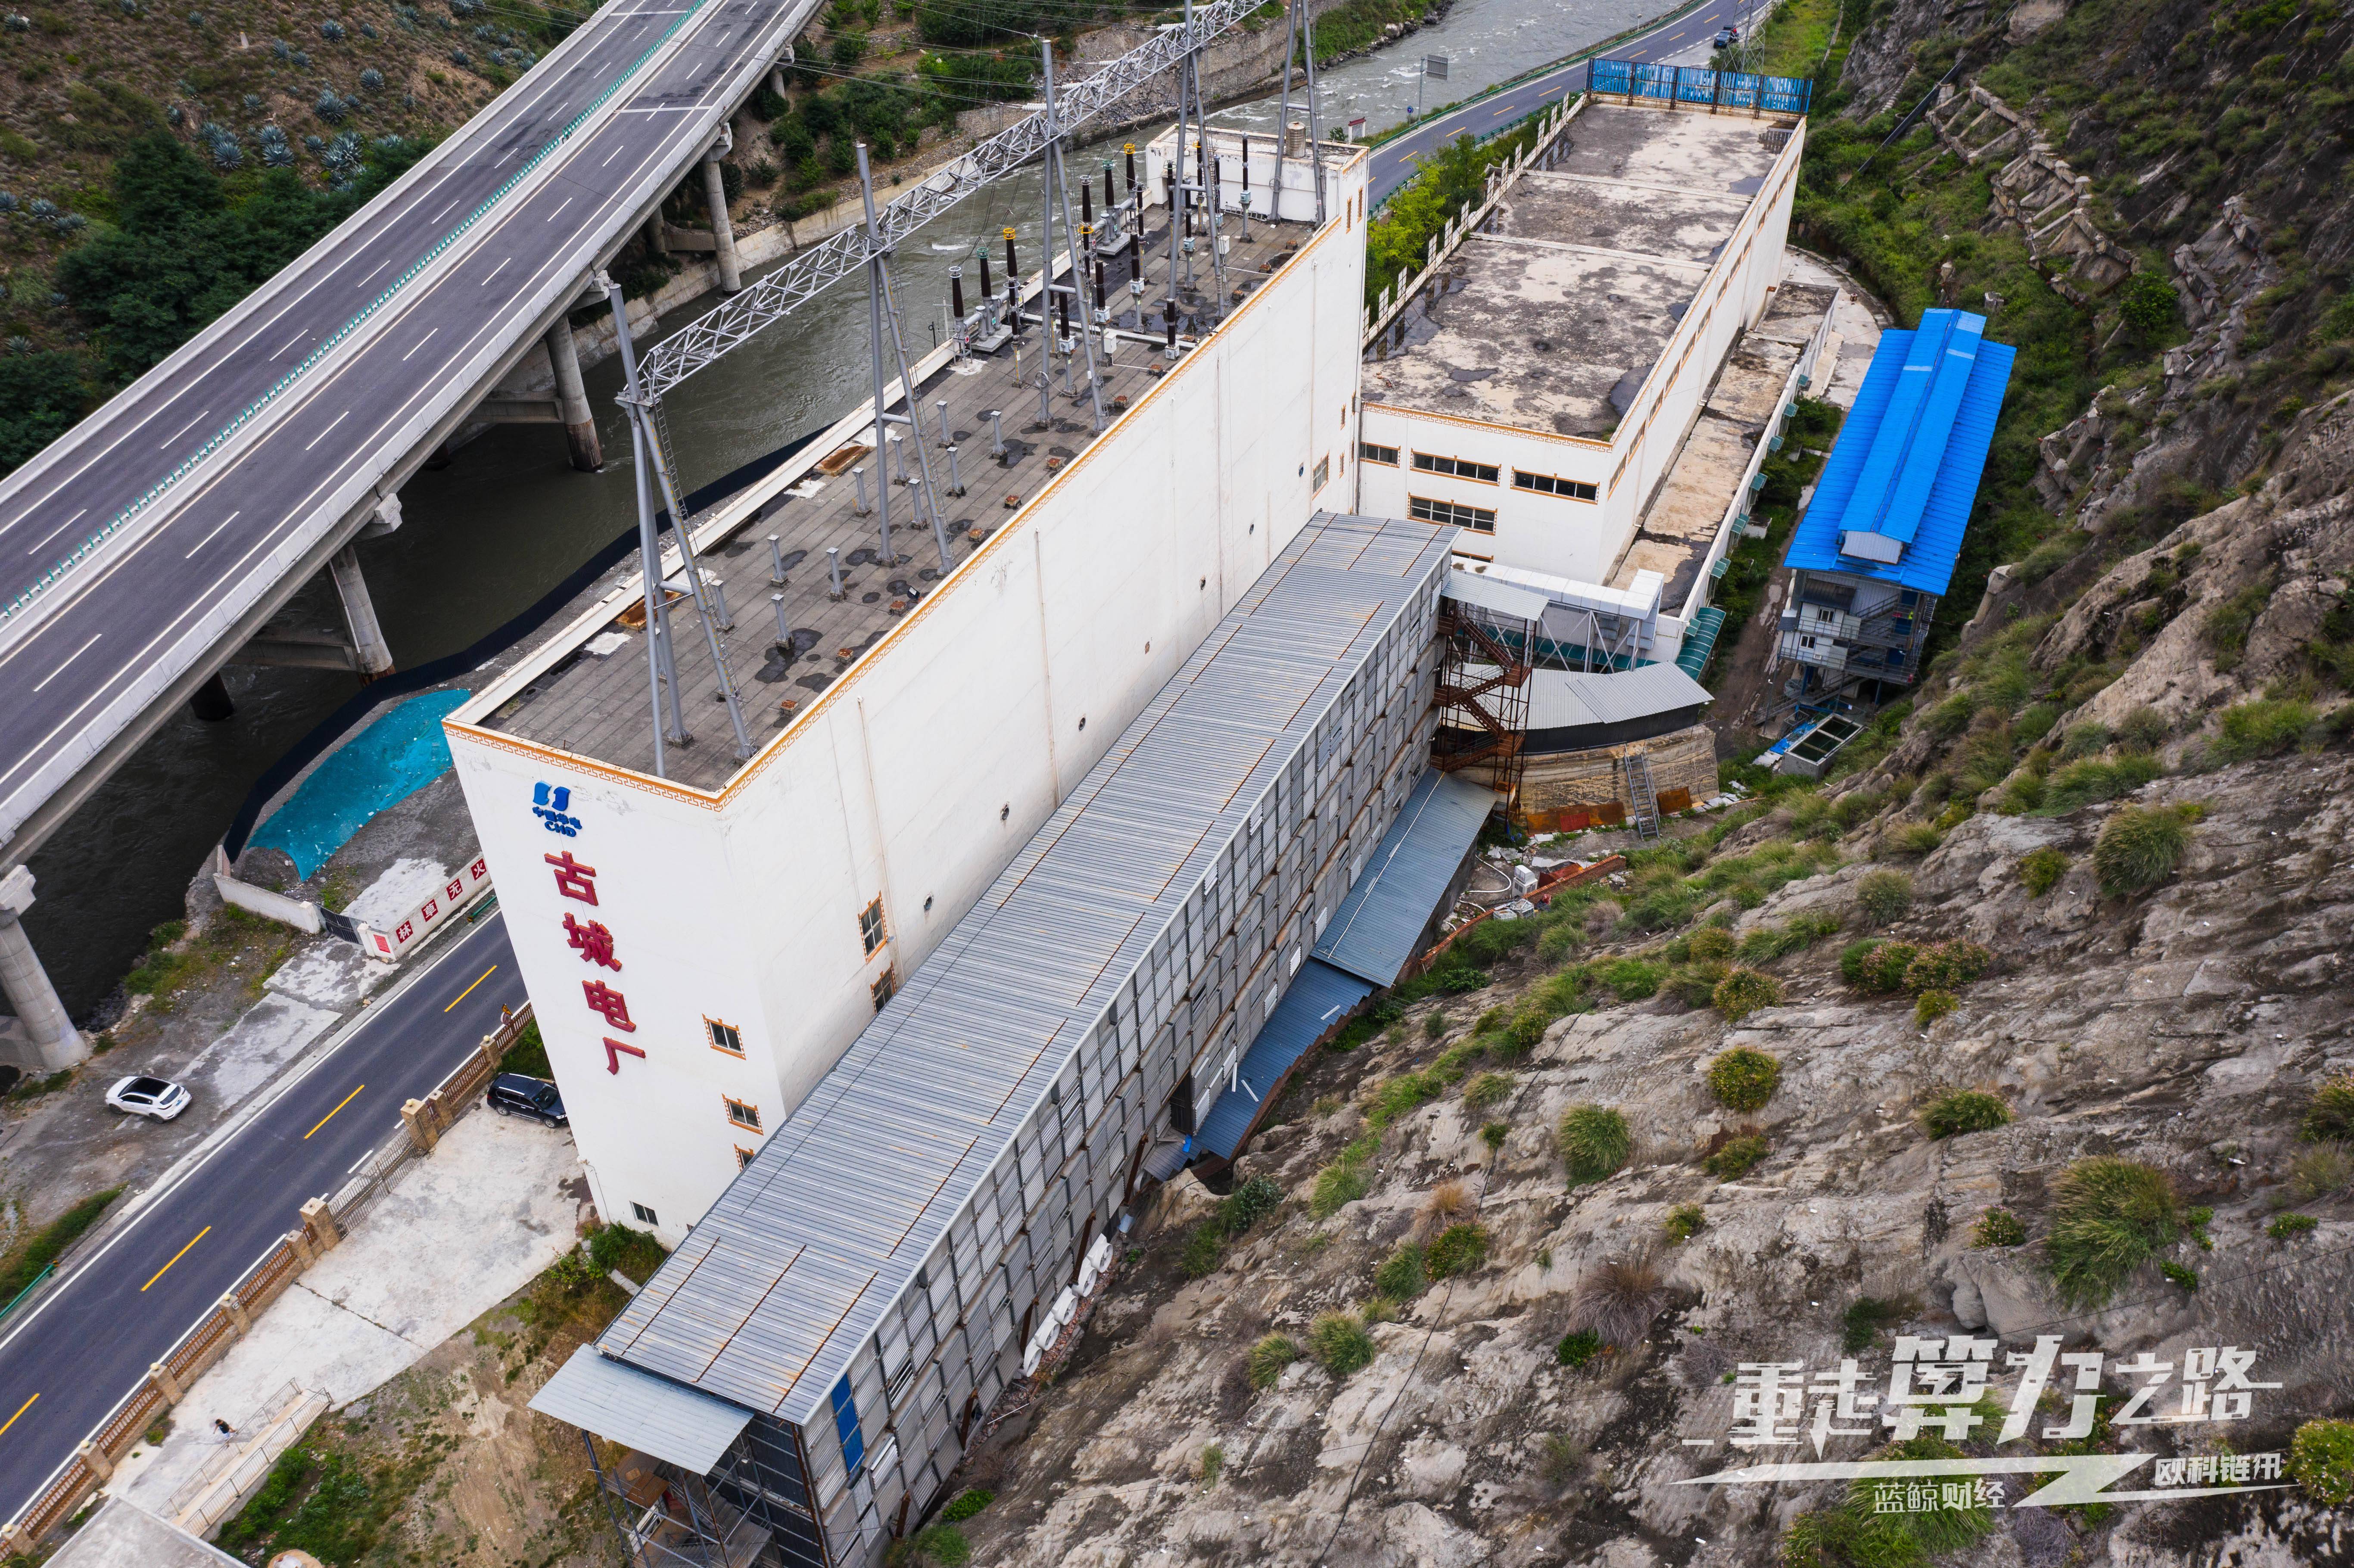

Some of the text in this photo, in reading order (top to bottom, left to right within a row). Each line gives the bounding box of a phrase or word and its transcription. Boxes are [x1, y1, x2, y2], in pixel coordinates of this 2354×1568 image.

[545, 821, 576, 837] CHD
[544, 850, 645, 1075] 古城电厂
